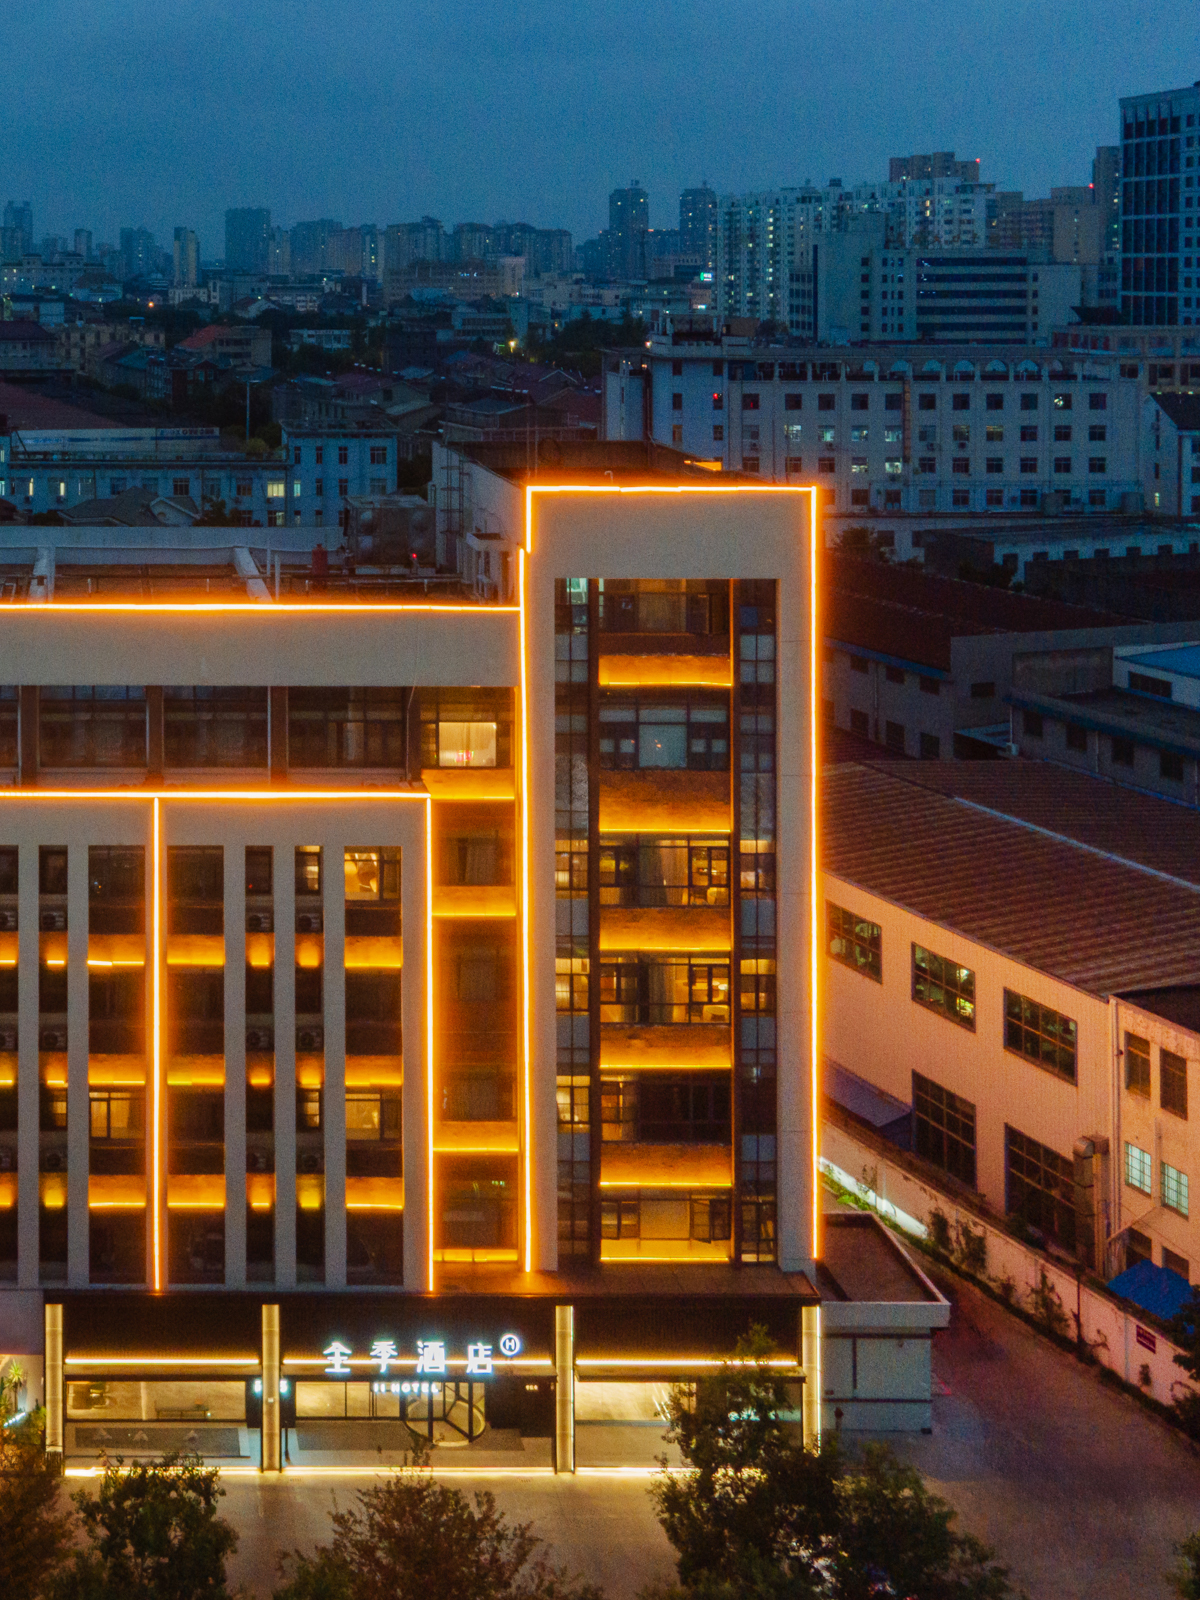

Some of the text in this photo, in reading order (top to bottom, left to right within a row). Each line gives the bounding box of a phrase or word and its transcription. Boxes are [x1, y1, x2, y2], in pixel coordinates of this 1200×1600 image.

[322, 1340, 493, 1374] 全季酒店
[390, 1382, 439, 1394] HOTEL
